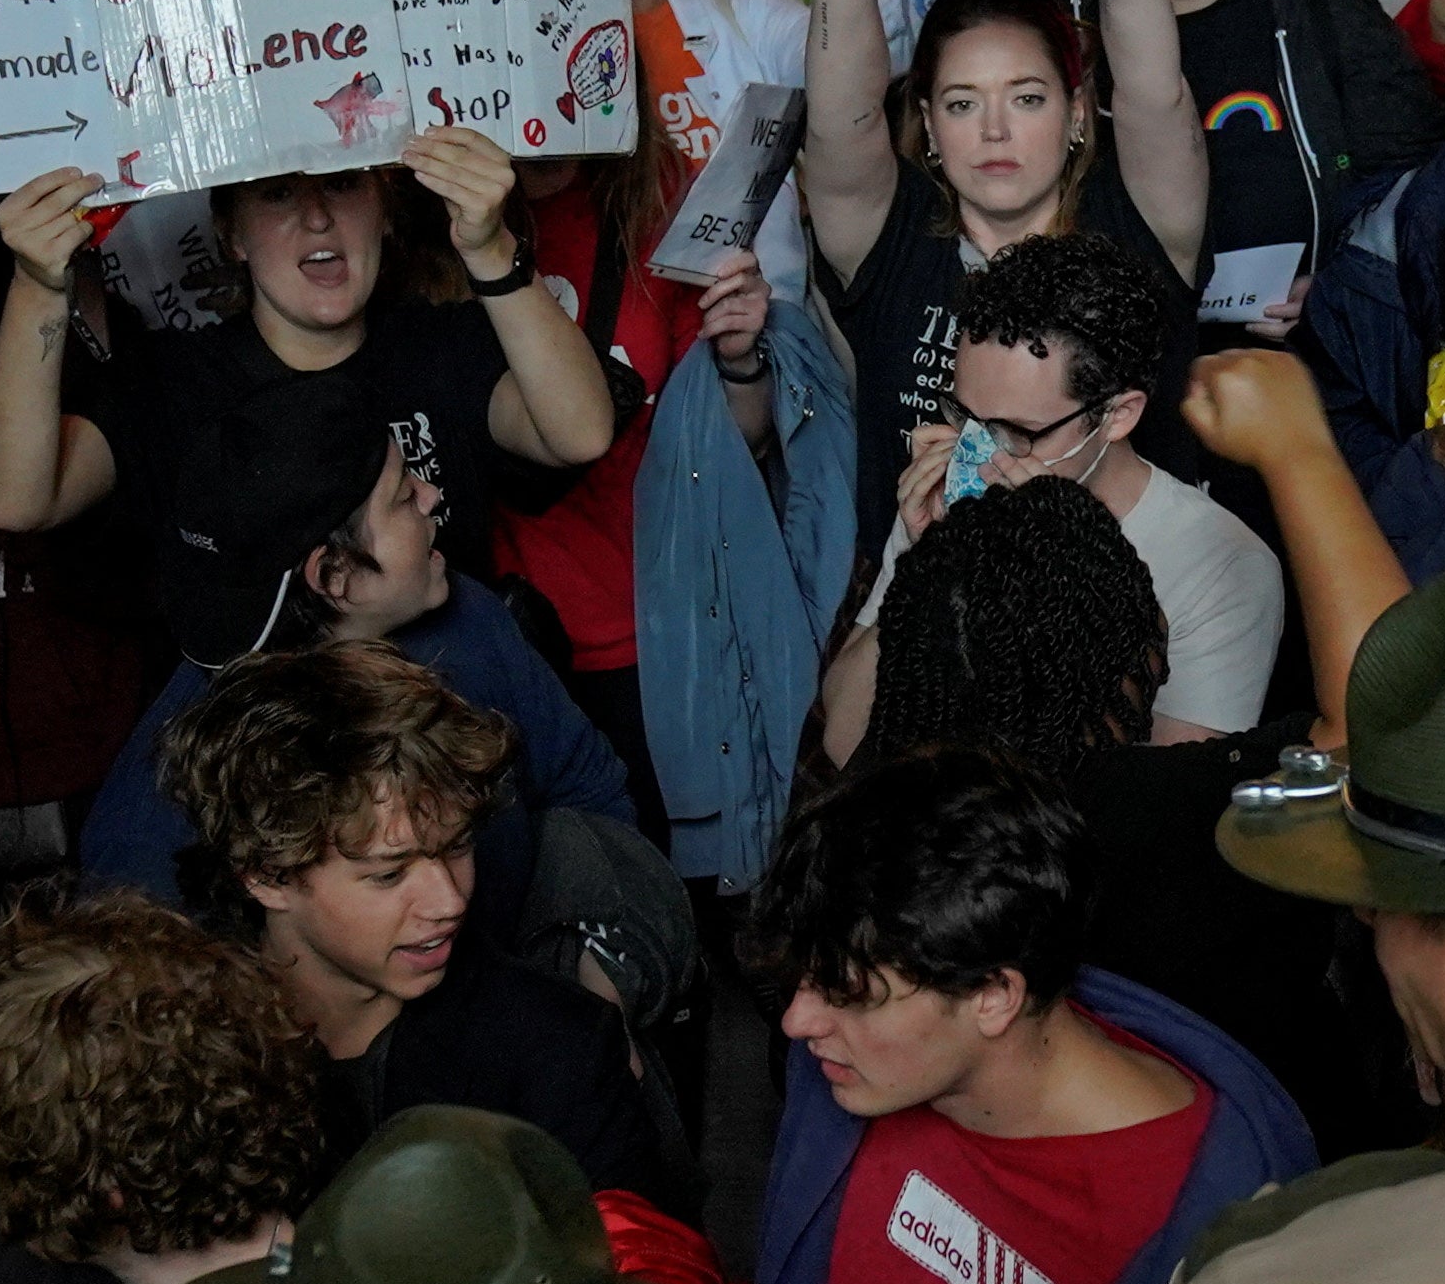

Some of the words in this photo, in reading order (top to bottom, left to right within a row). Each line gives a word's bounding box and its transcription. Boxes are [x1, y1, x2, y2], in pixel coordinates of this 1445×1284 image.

[507, 47, 525, 68] to
[691, 213, 728, 245] BE
[177, 224, 219, 276] WE
[1240, 292, 1257, 307] is
[898, 391, 939, 412] who
[899, 1209, 974, 1281] adidas
